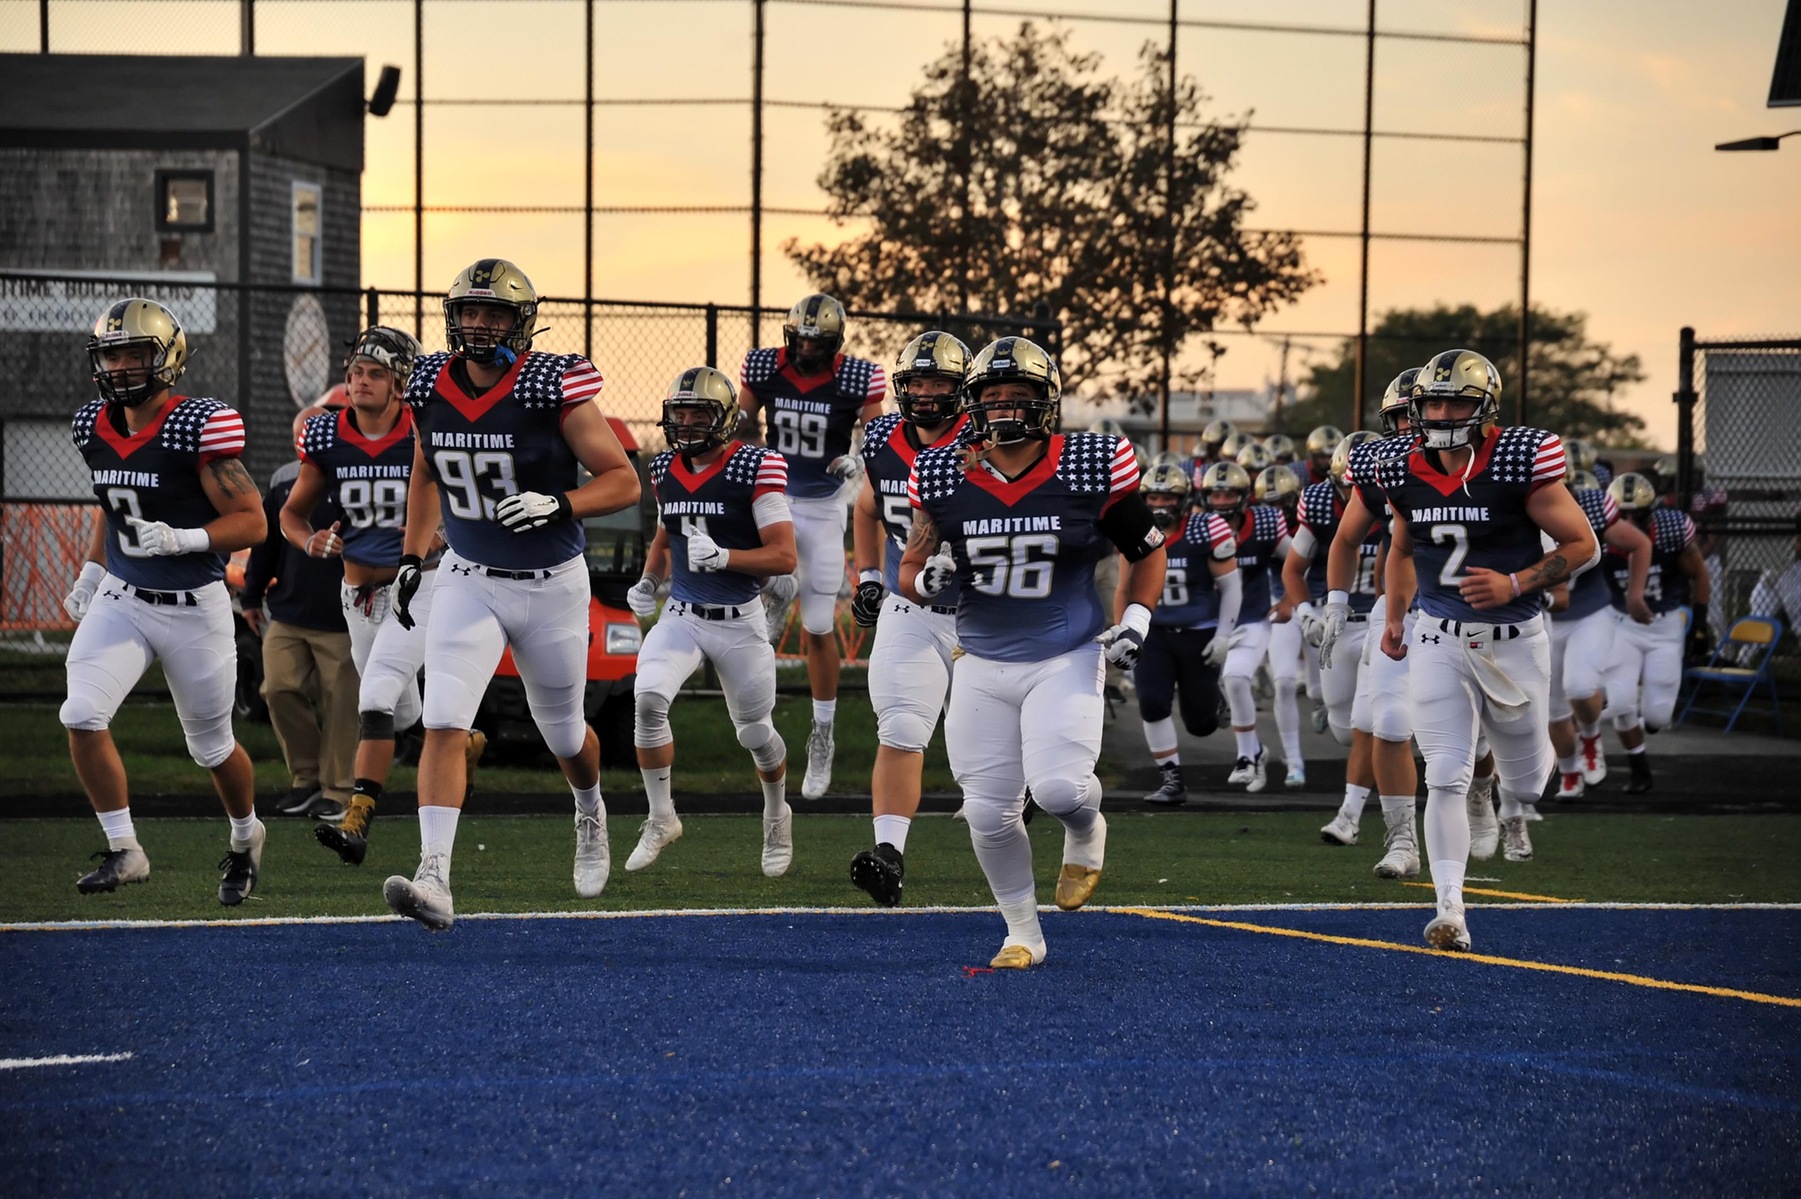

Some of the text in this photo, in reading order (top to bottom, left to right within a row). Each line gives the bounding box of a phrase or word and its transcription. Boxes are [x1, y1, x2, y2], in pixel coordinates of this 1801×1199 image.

[774, 397, 832, 415] MARITIME
[431, 431, 515, 449] MARITIME
[774, 410, 828, 458] 89
[93, 469, 160, 488] MARITIME
[336, 465, 410, 479] MARITIME
[433, 449, 520, 521] 93
[340, 480, 408, 529] 88
[663, 501, 725, 515] MARITIME
[1411, 507, 1490, 523] MARITIME
[106, 487, 150, 558] 3
[883, 495, 913, 552] 5
[962, 516, 1062, 535] MARITIME
[965, 533, 1060, 599] 56
[1430, 523, 1471, 587] 2
